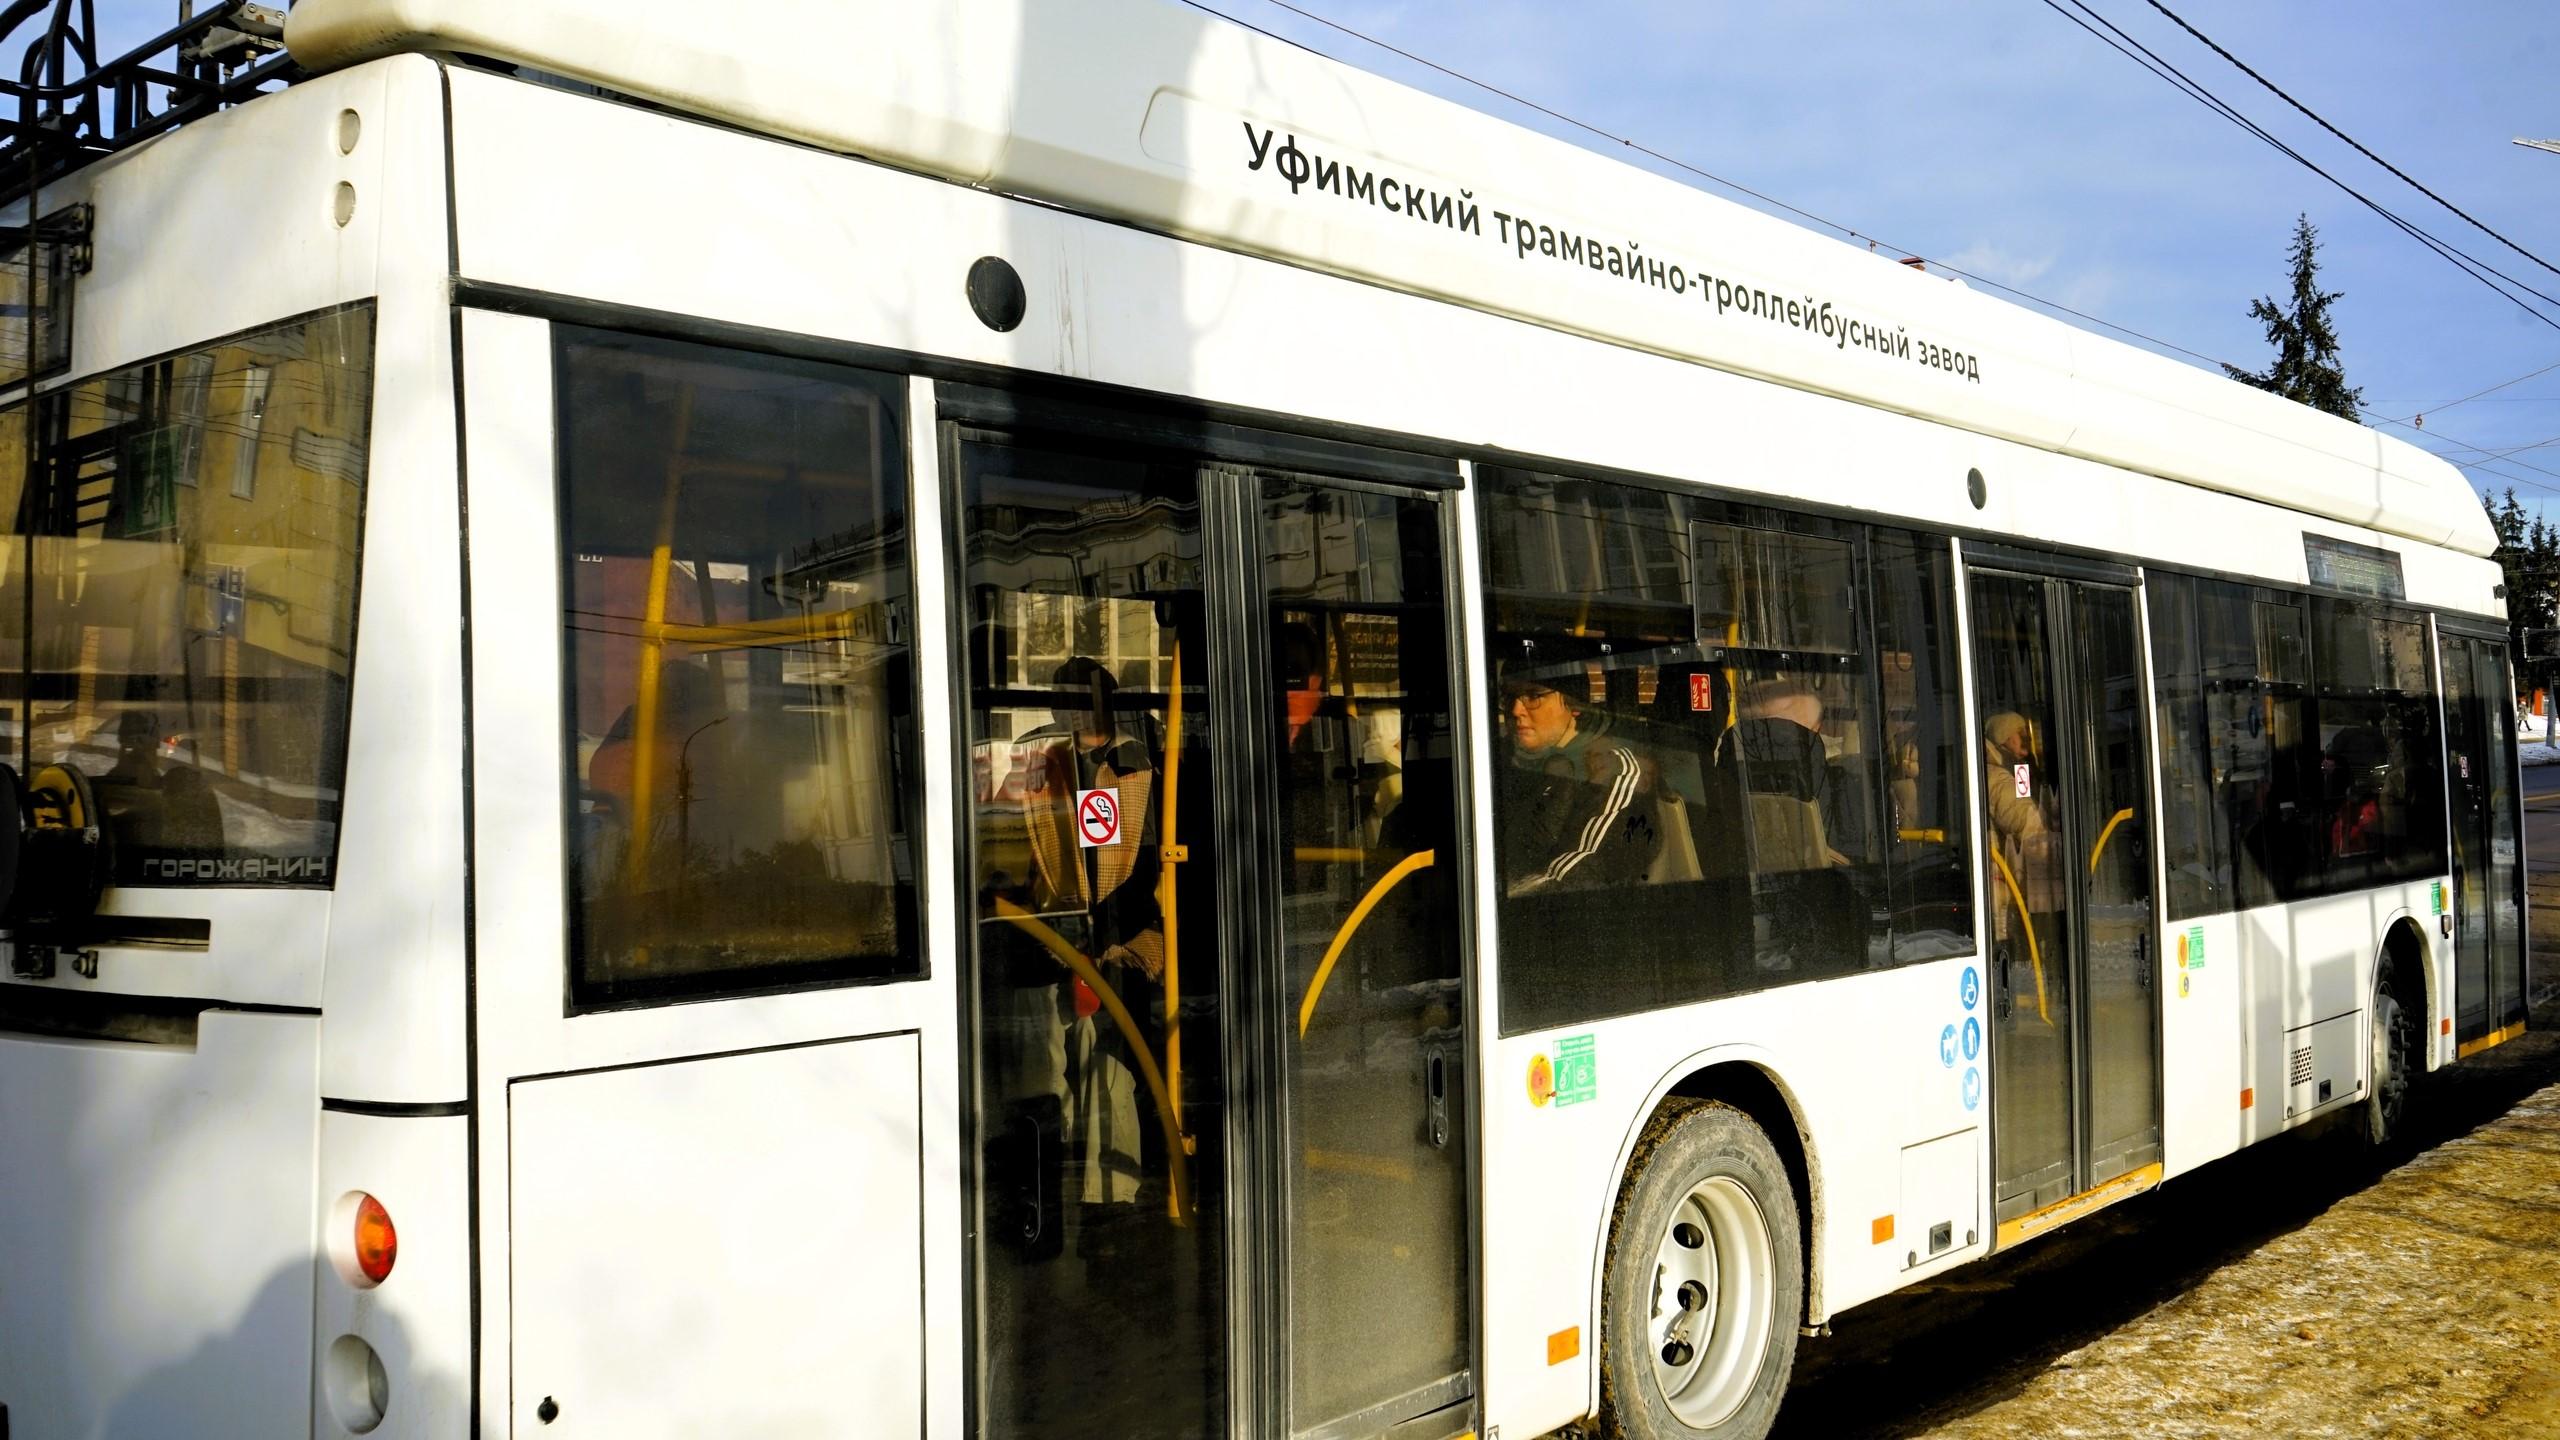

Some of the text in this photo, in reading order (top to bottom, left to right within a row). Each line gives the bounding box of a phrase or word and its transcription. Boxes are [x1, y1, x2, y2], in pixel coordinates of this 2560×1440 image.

[1243, 121, 1980, 384] Уфимский трамвайно-троллейбусный завод
[144, 857, 327, 878] ГОРОЖАНИН
